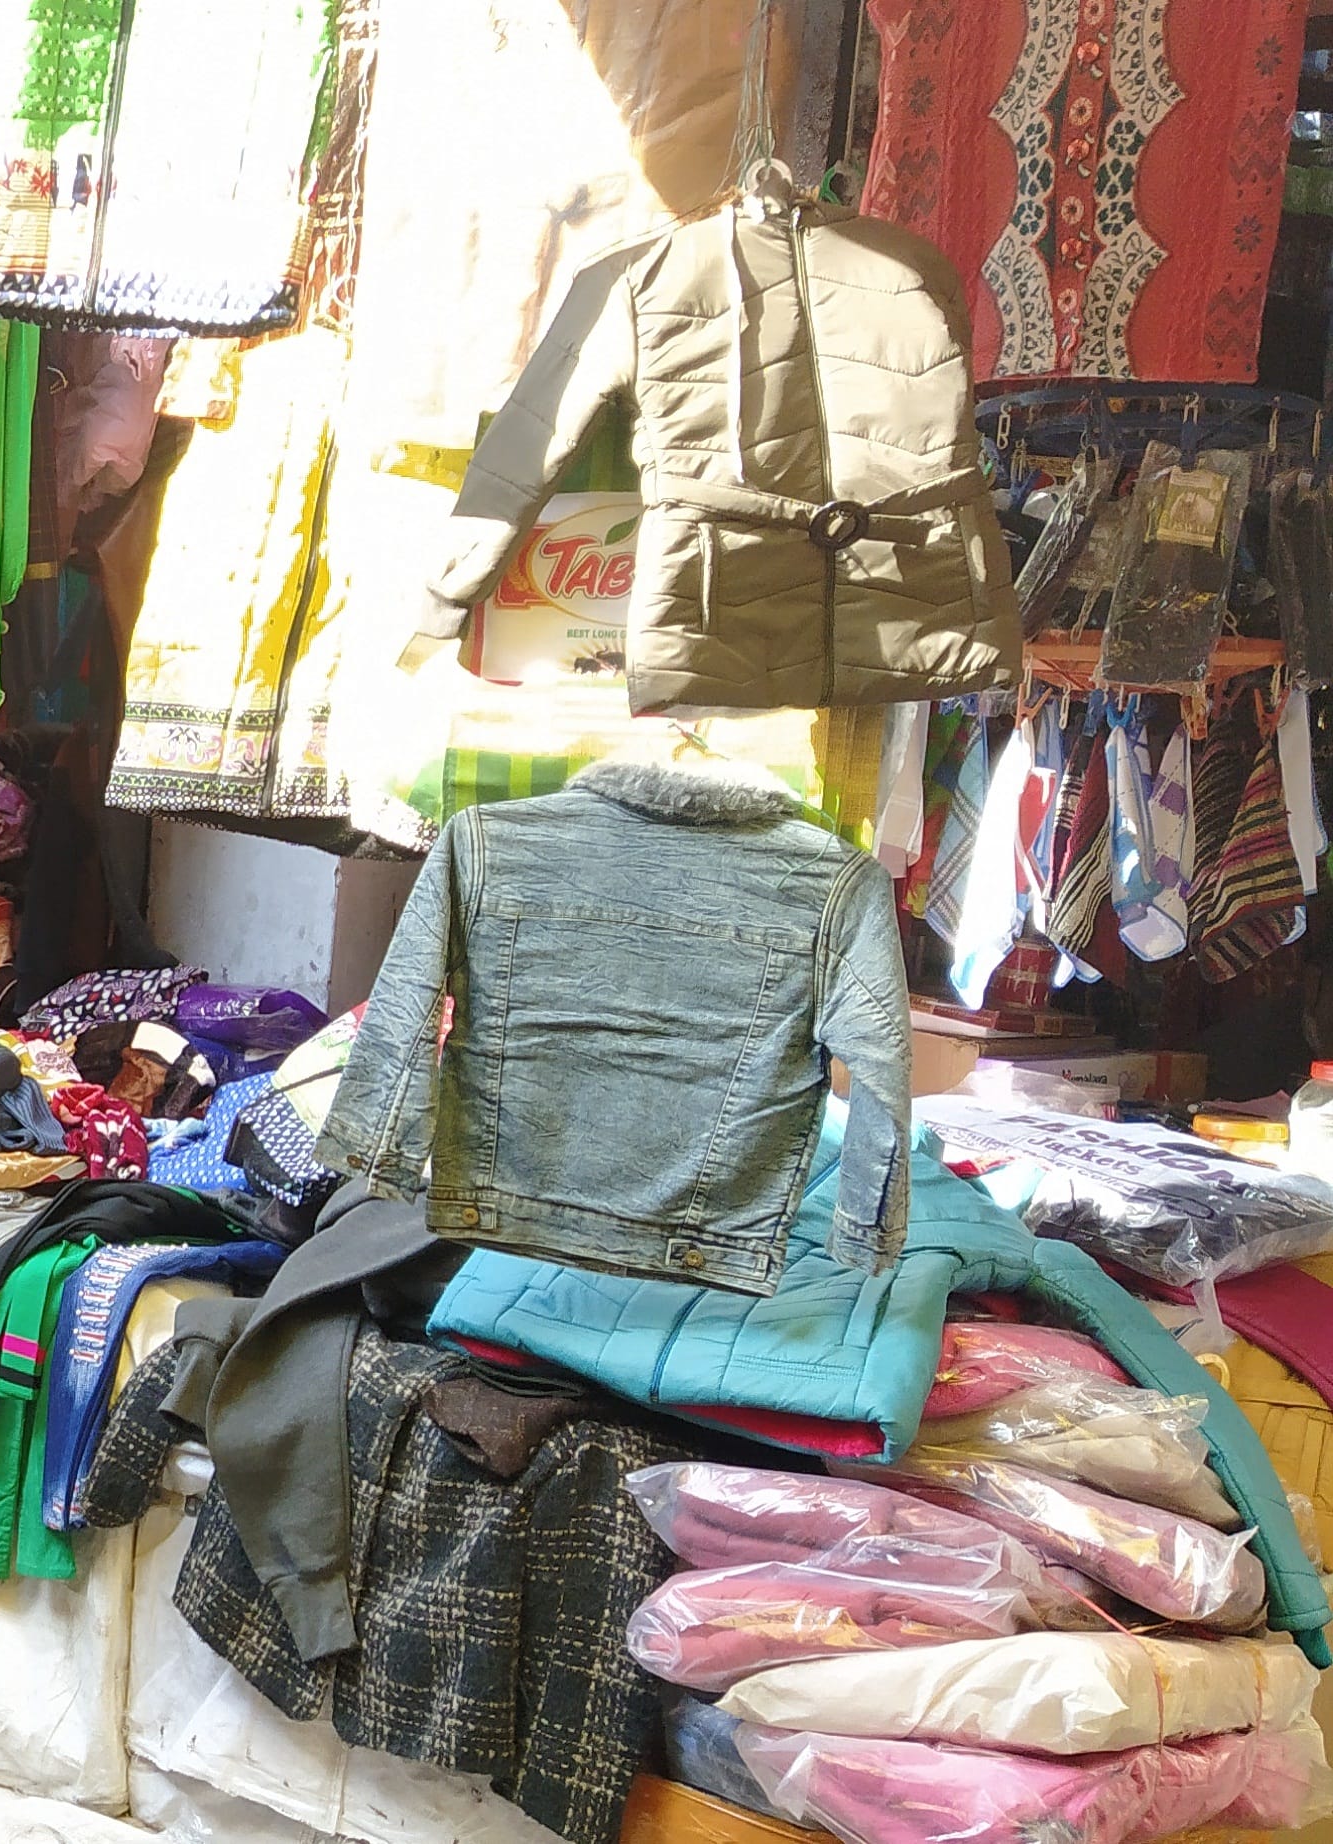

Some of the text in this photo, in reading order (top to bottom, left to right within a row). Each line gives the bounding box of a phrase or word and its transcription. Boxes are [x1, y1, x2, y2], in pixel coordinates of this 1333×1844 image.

[566, 629, 590, 638] BEST
[593, 629, 617, 639] LONG
[1027, 1136, 1142, 1176] Jackets
